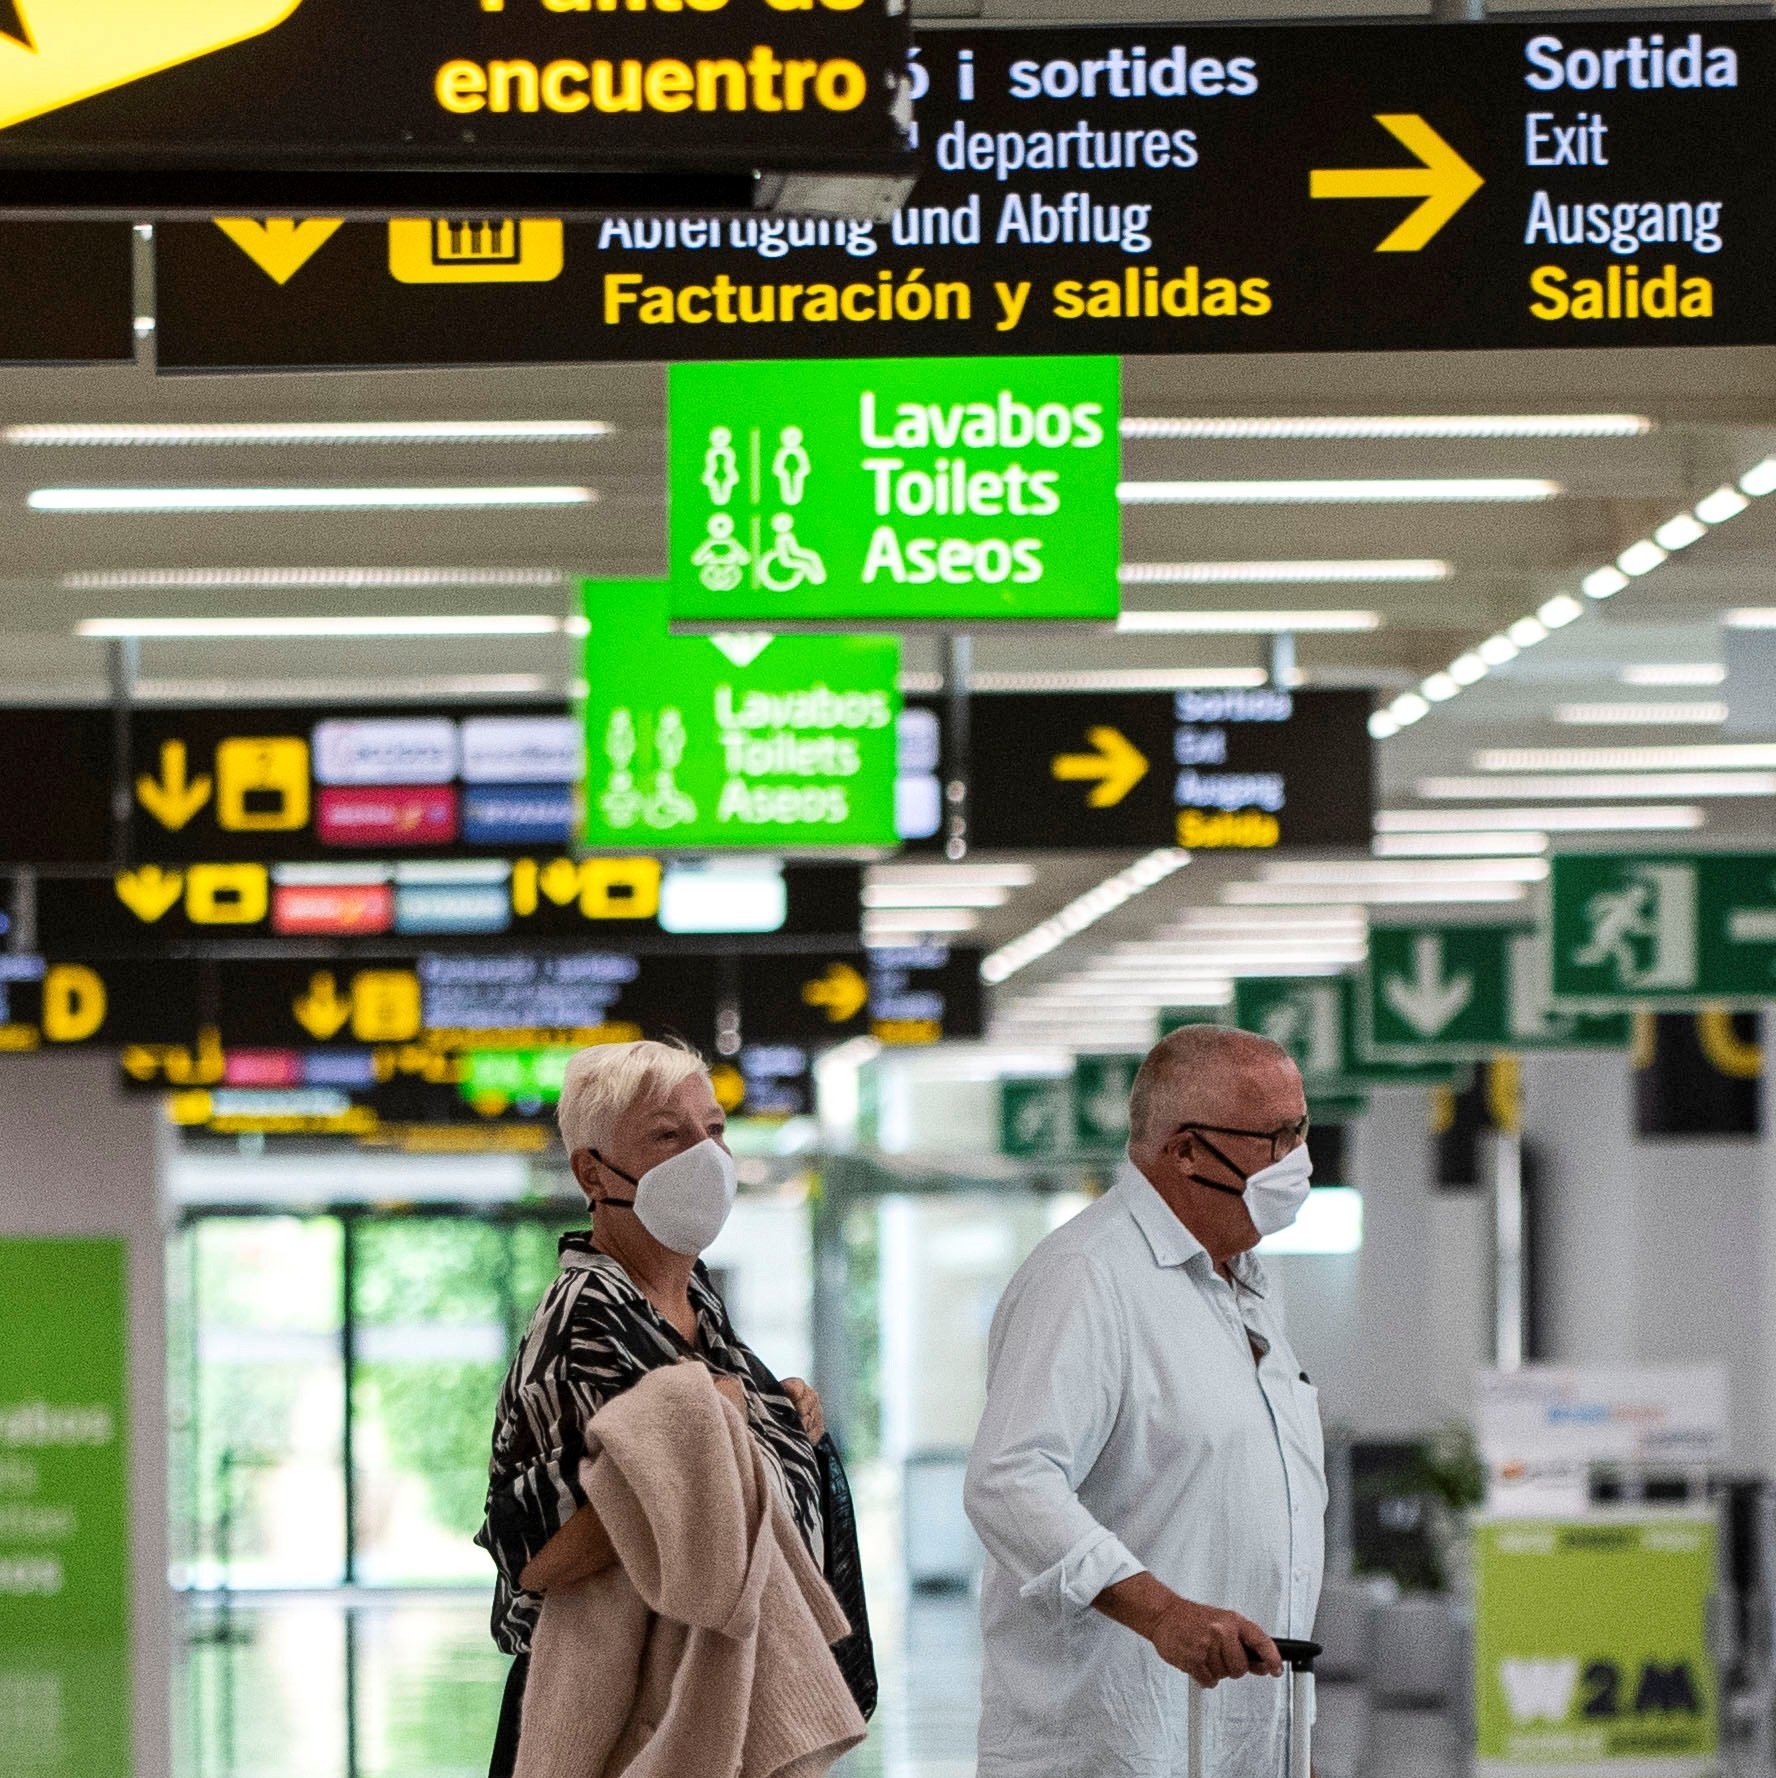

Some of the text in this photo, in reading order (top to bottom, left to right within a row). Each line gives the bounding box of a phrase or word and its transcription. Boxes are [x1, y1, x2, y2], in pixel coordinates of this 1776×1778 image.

[435, 45, 867, 113] encuentro
[958, 48, 975, 100] i
[1009, 45, 1258, 98] sortides
[1525, 33, 1738, 90] Sortida
[936, 120, 1199, 181] departures
[1526, 112, 1609, 166] Exit
[891, 193, 981, 246] und
[996, 192, 1152, 253] Abflug
[1525, 190, 1723, 254] Ausgang
[604, 266, 1272, 331] Facturación y salidas
[1529, 264, 1714, 320] Salida
[860, 391, 1104, 449] Lavabos
[861, 458, 1061, 517] Toilets
[861, 526, 1044, 584] Aseos
[715, 685, 893, 730] Lavabos
[720, 733, 862, 776] Toilets
[718, 777, 849, 825] Aseos
